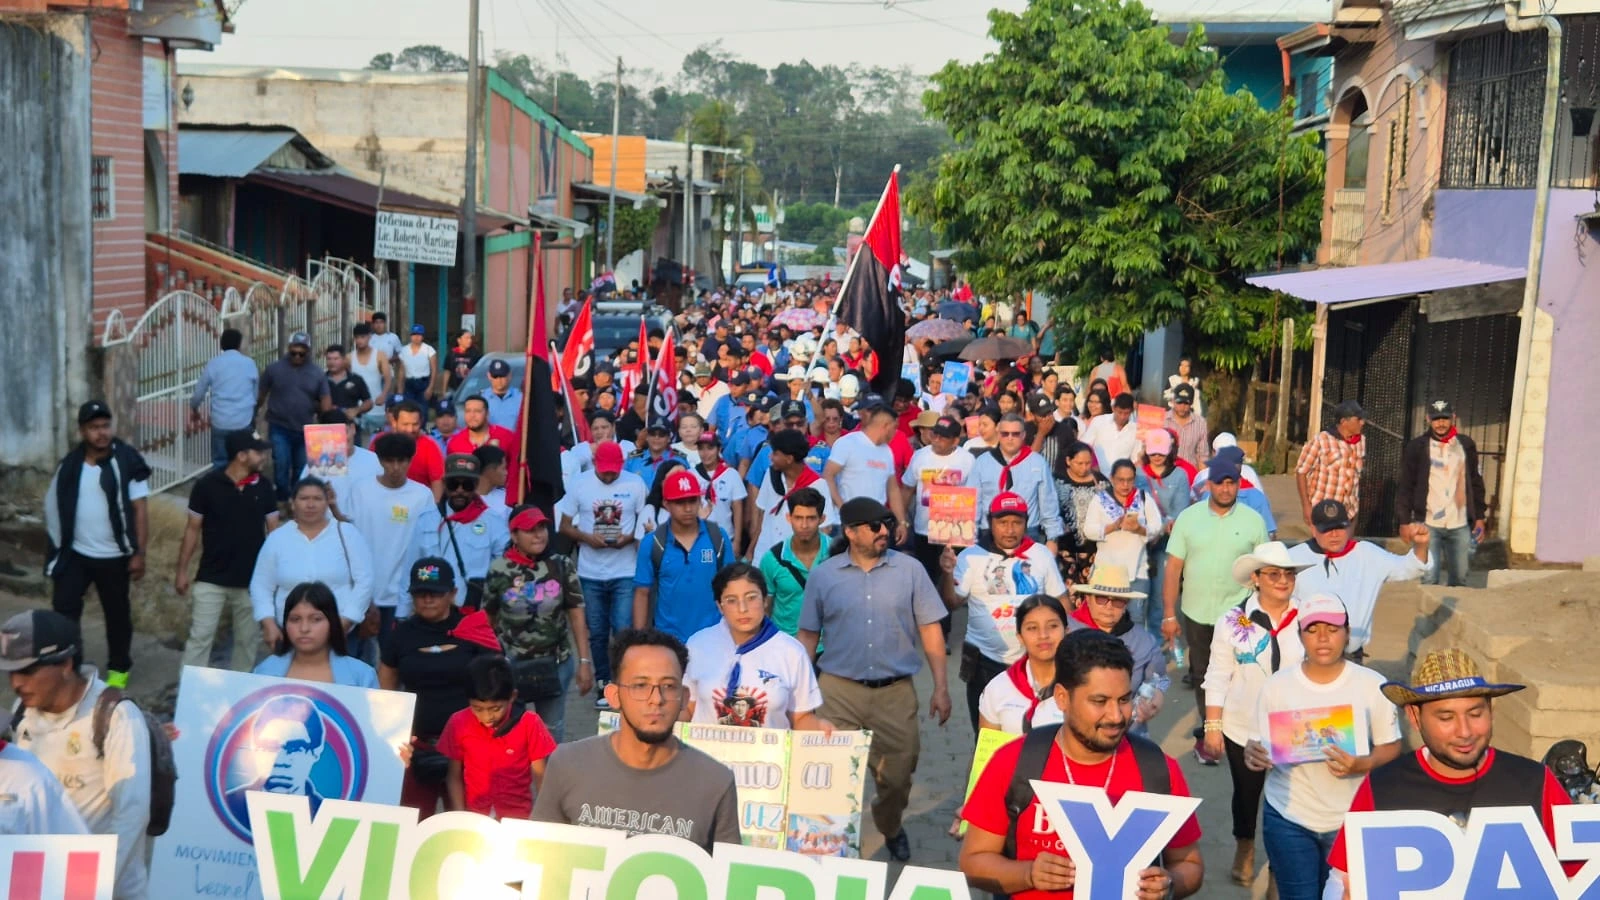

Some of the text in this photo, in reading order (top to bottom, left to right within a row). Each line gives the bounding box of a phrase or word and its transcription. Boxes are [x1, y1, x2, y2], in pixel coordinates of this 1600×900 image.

[379, 213, 457, 231] Oficina de Leyes
[394, 228, 420, 245] Roberto
[1425, 678, 1476, 692] NICARAGUA
[579, 803, 693, 838] AMERICAN
[175, 845, 258, 867] MOVIMIEN
[1057, 799, 1170, 900] Y
